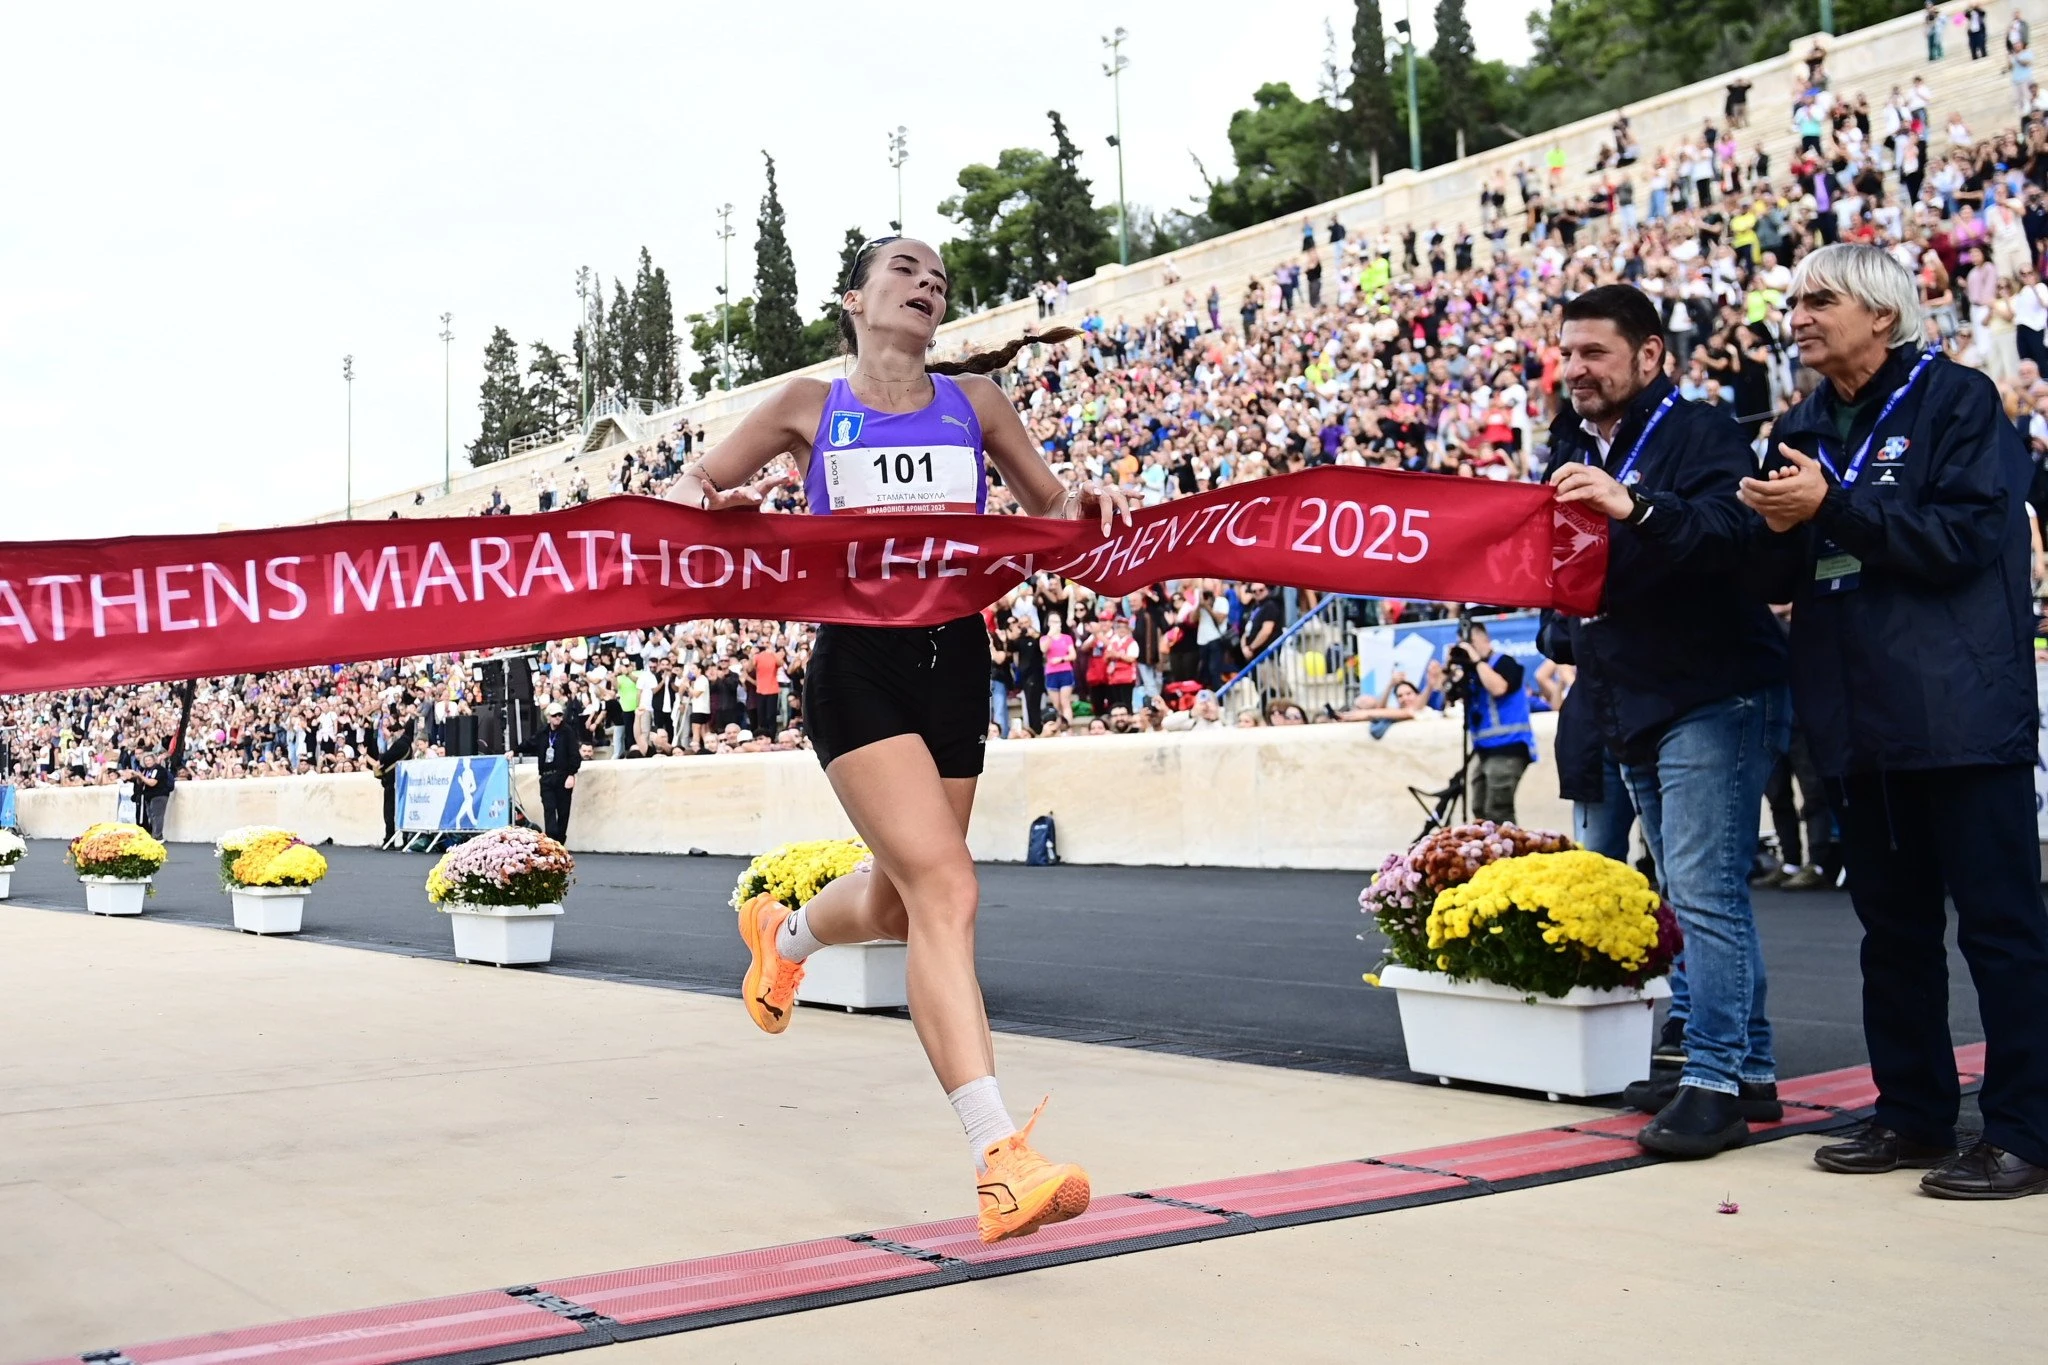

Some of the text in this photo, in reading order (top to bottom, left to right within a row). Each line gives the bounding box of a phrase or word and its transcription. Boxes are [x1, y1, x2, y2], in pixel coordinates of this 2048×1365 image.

[830, 459, 840, 486] BLOCK
[873, 452, 933, 484] 101
[876, 492, 946, 502] ΣΤΑΜΑΤΙΑ ΝΟΥΛΑ
[931, 503, 946, 511] 2025
[333, 529, 807, 614] MARATHON.
[1291, 497, 1431, 564] 2025
